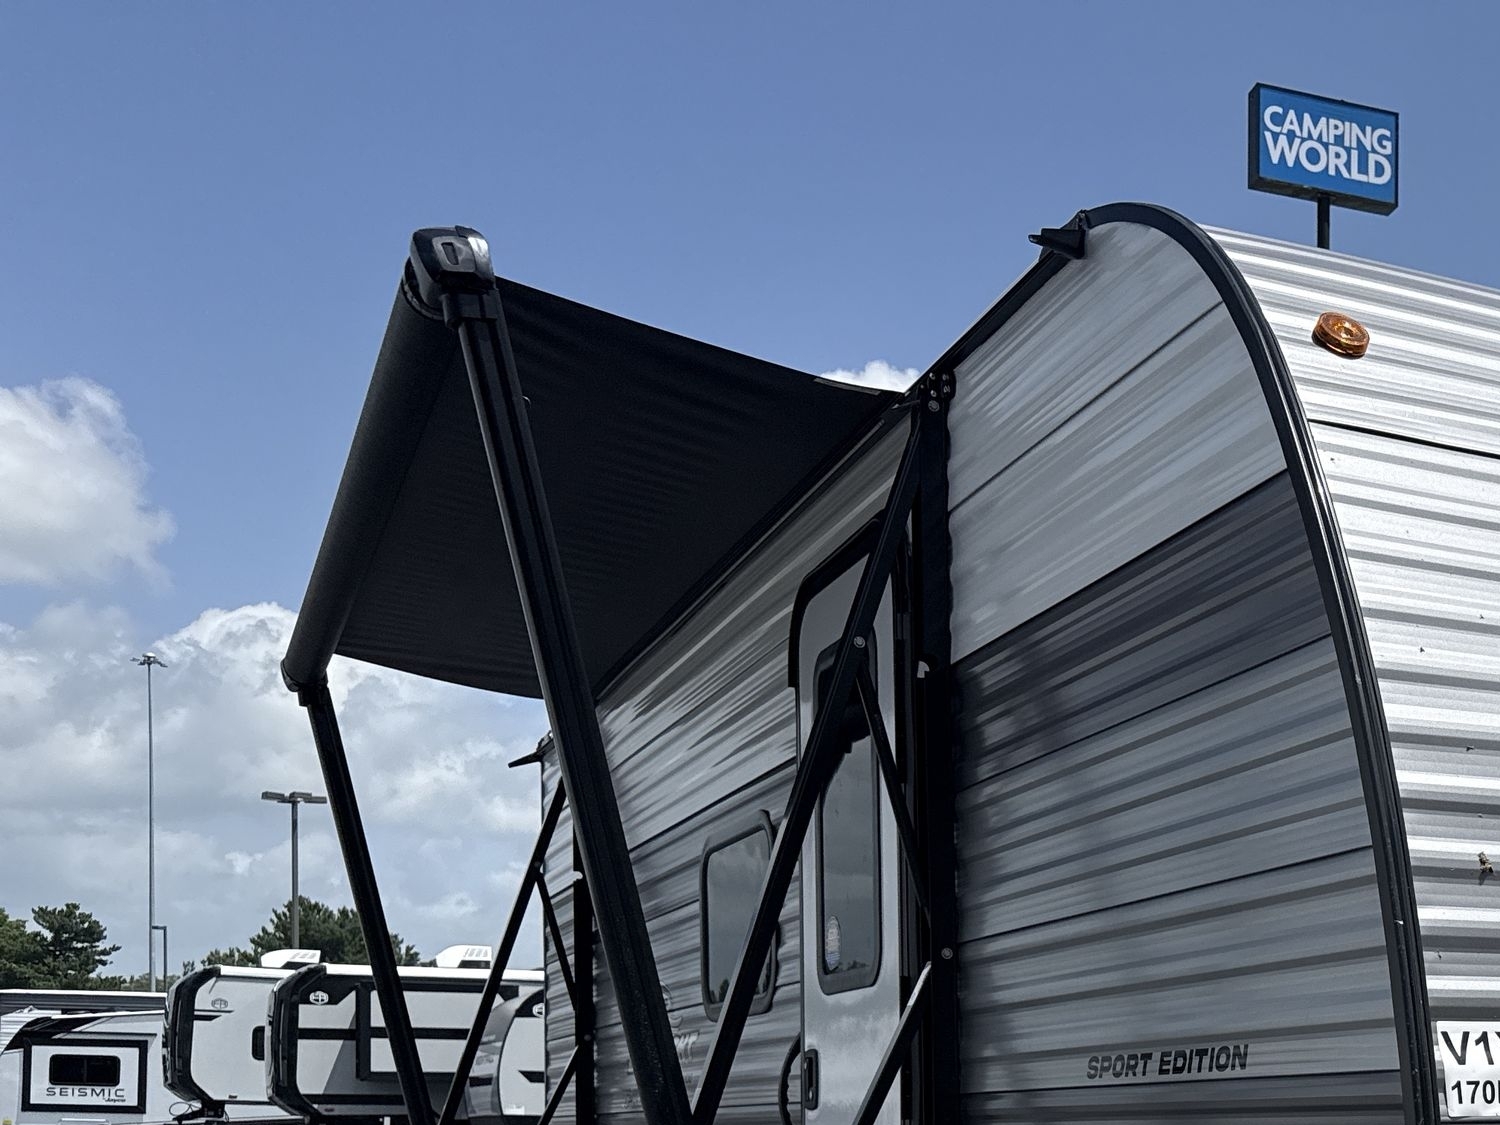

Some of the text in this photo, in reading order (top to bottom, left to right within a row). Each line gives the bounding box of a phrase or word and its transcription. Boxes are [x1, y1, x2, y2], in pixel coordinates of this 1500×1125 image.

[1263, 105, 1392, 155] CAMPING
[1263, 130, 1392, 185] WORLD
[1086, 1044, 1249, 1079] SPORT EDITION
[46, 1086, 125, 1098] SEISMIC
